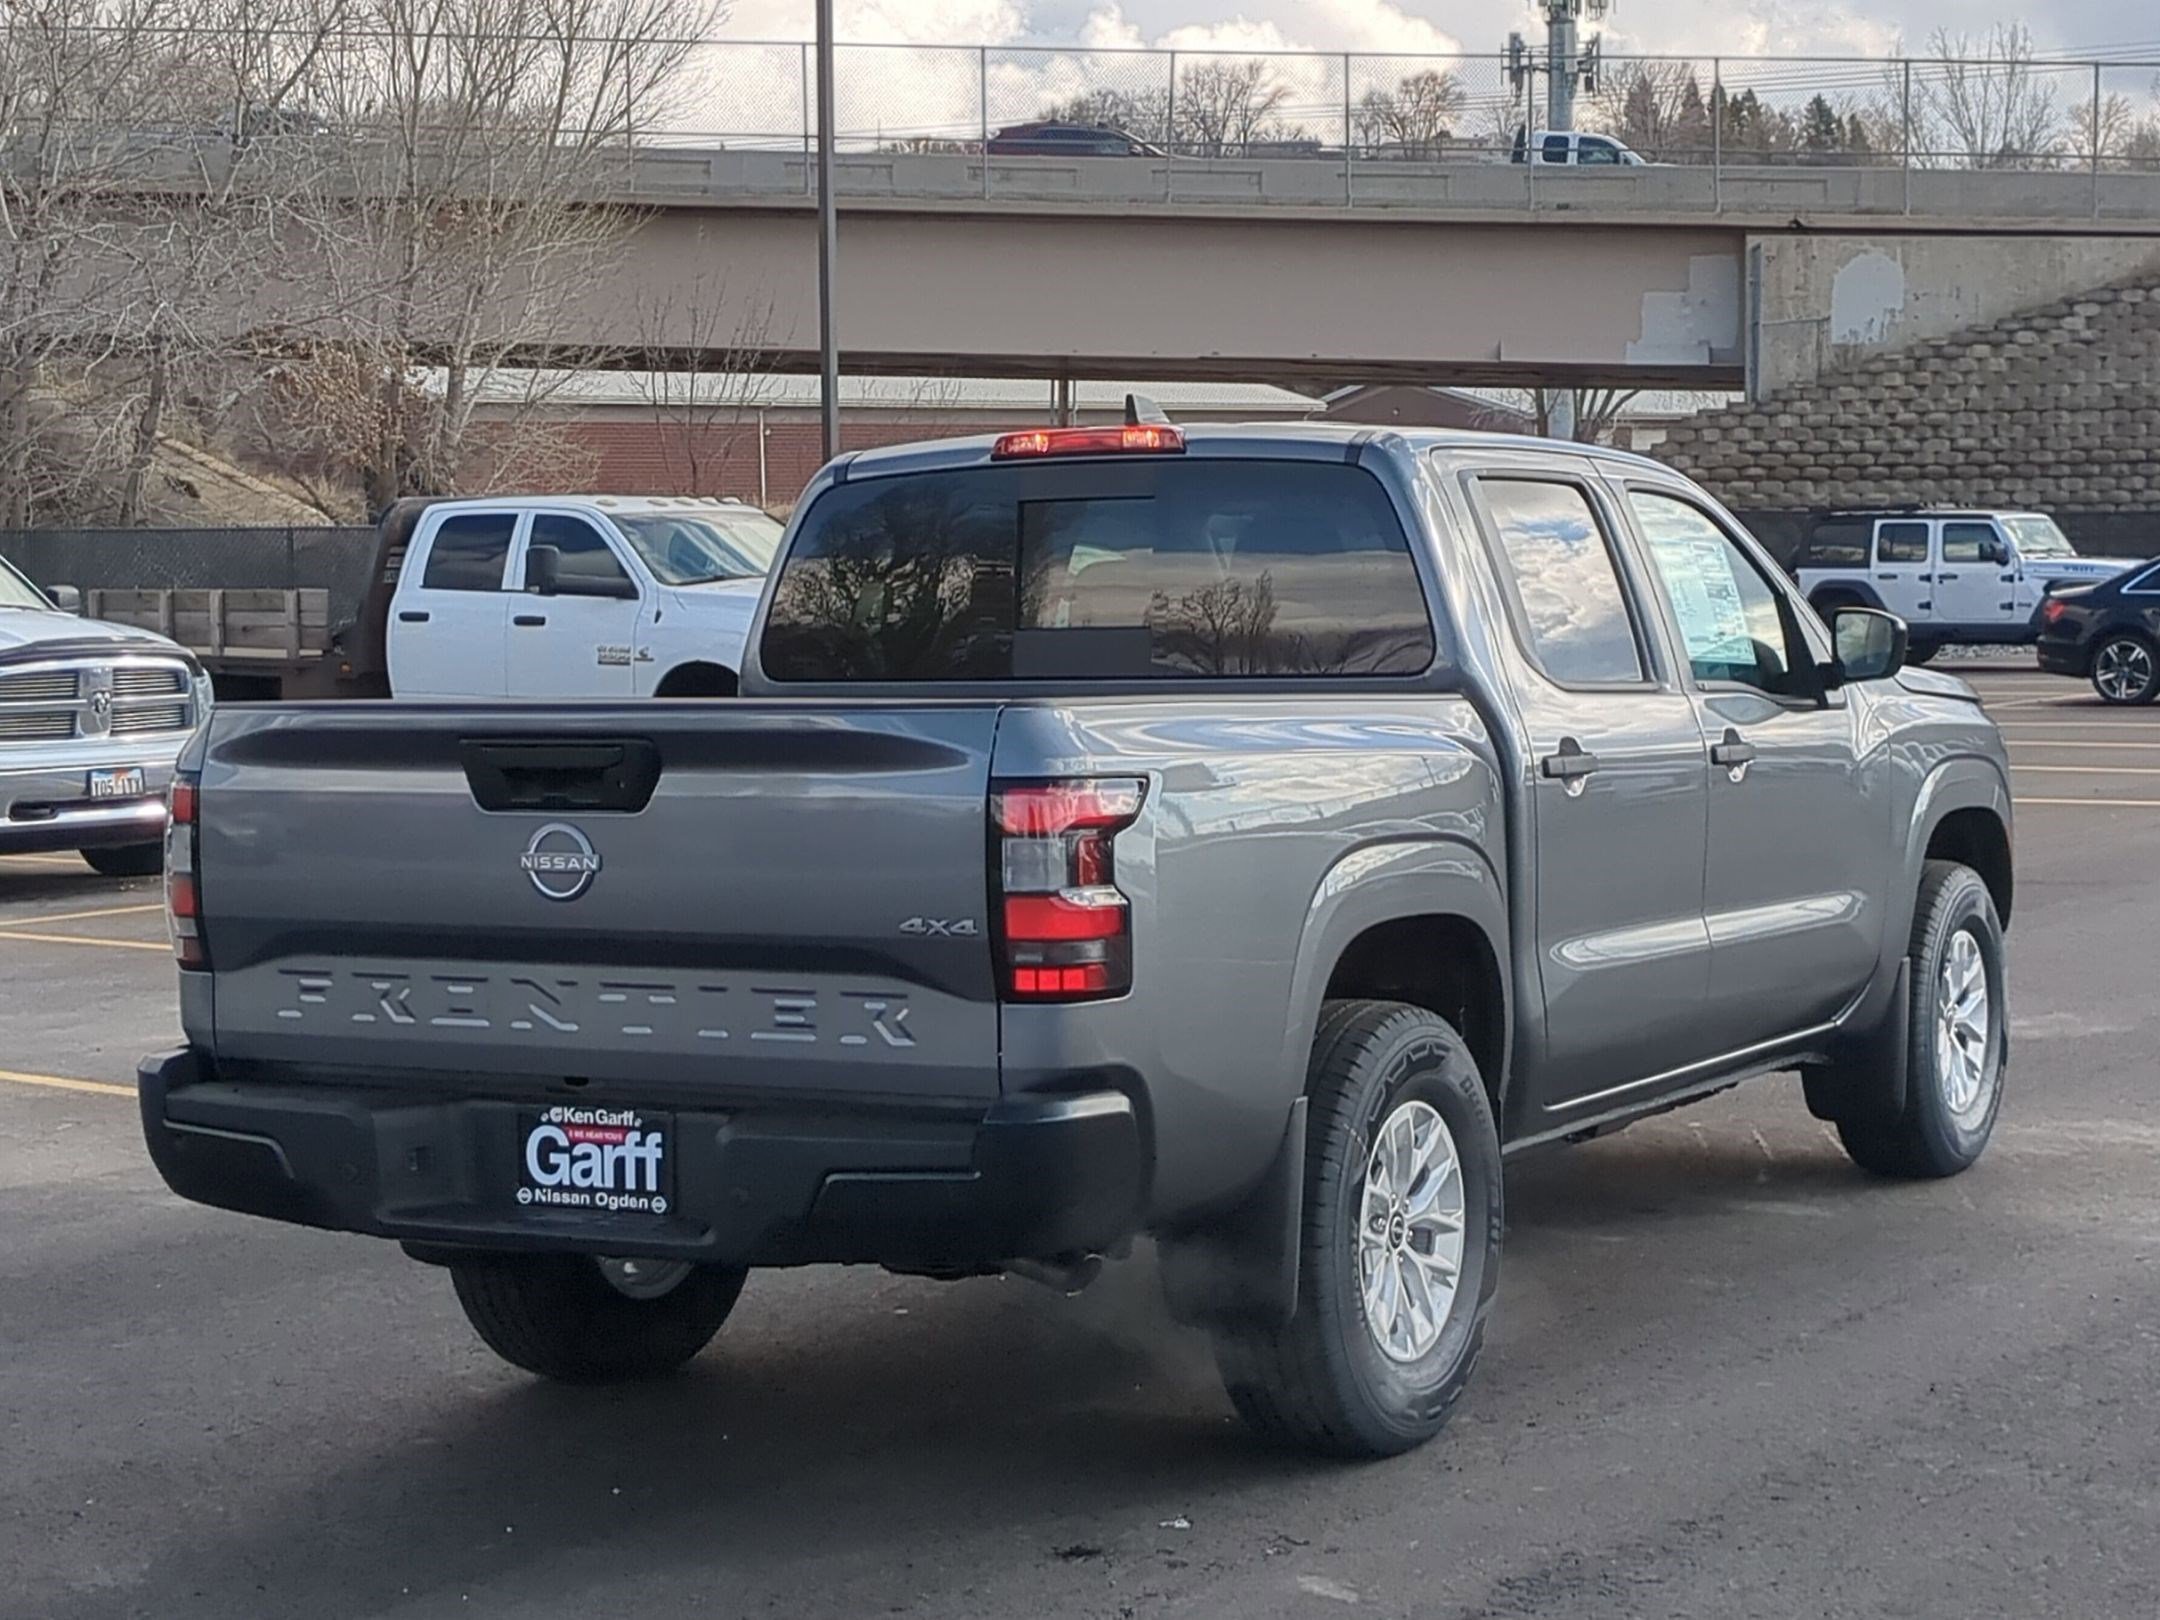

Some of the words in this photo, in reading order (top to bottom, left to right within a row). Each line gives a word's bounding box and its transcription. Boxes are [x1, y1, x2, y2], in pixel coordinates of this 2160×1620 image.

[520, 855, 597, 870] NISSAN
[277, 968, 916, 1047] FRONTIER
[563, 1106, 594, 1125] Ken
[595, 1108, 635, 1127] Garff
[525, 1124, 663, 1191] Garff
[534, 1188, 590, 1205] Nissan
[595, 1192, 649, 1211] Ogden
